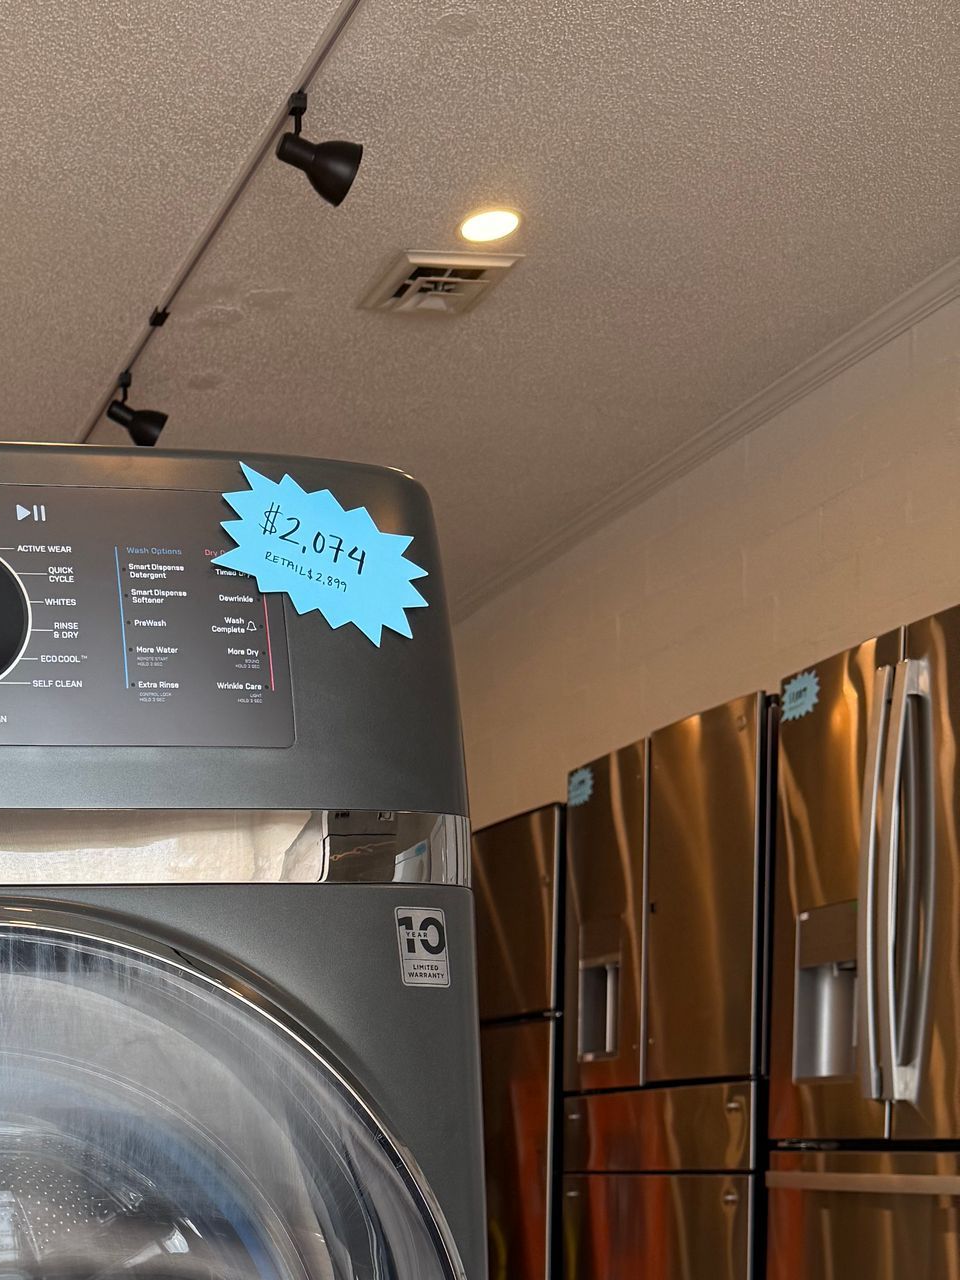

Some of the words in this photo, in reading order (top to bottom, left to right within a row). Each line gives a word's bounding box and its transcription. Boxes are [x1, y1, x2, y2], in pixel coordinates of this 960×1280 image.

[259, 501, 367, 575] $2,074
[17, 544, 46, 553] ACTIVE
[47, 544, 72, 553] WEAR
[126, 546, 150, 555] Wash
[151, 547, 182, 557] Options
[264, 551, 306, 576] RETAIL
[48, 566, 74, 575] QUICK
[48, 574, 74, 583] CYCLE
[129, 571, 167, 580] Detergent
[44, 598, 76, 606] WHITES
[132, 597, 164, 605] Softener
[218, 594, 254, 603] Dewrinkle
[134, 619, 167, 627] PreWash
[224, 616, 245, 625] Wash
[53, 622, 79, 630] RINSE
[211, 625, 246, 634] Complete
[53, 631, 60, 639] &
[61, 631, 79, 639] DRY
[136, 646, 155, 654] More
[155, 646, 179, 654] Water
[227, 648, 245, 656] More
[246, 648, 259, 657] Dry
[32, 679, 54, 688] SELF
[54, 679, 83, 688] CLEAN
[138, 681, 159, 689] Extra
[159, 681, 179, 689] Rinse
[217, 682, 244, 690] Wrinkle
[245, 682, 262, 690] Care
[398, 916, 446, 955] 10
[407, 971, 445, 979] WARRANTY
